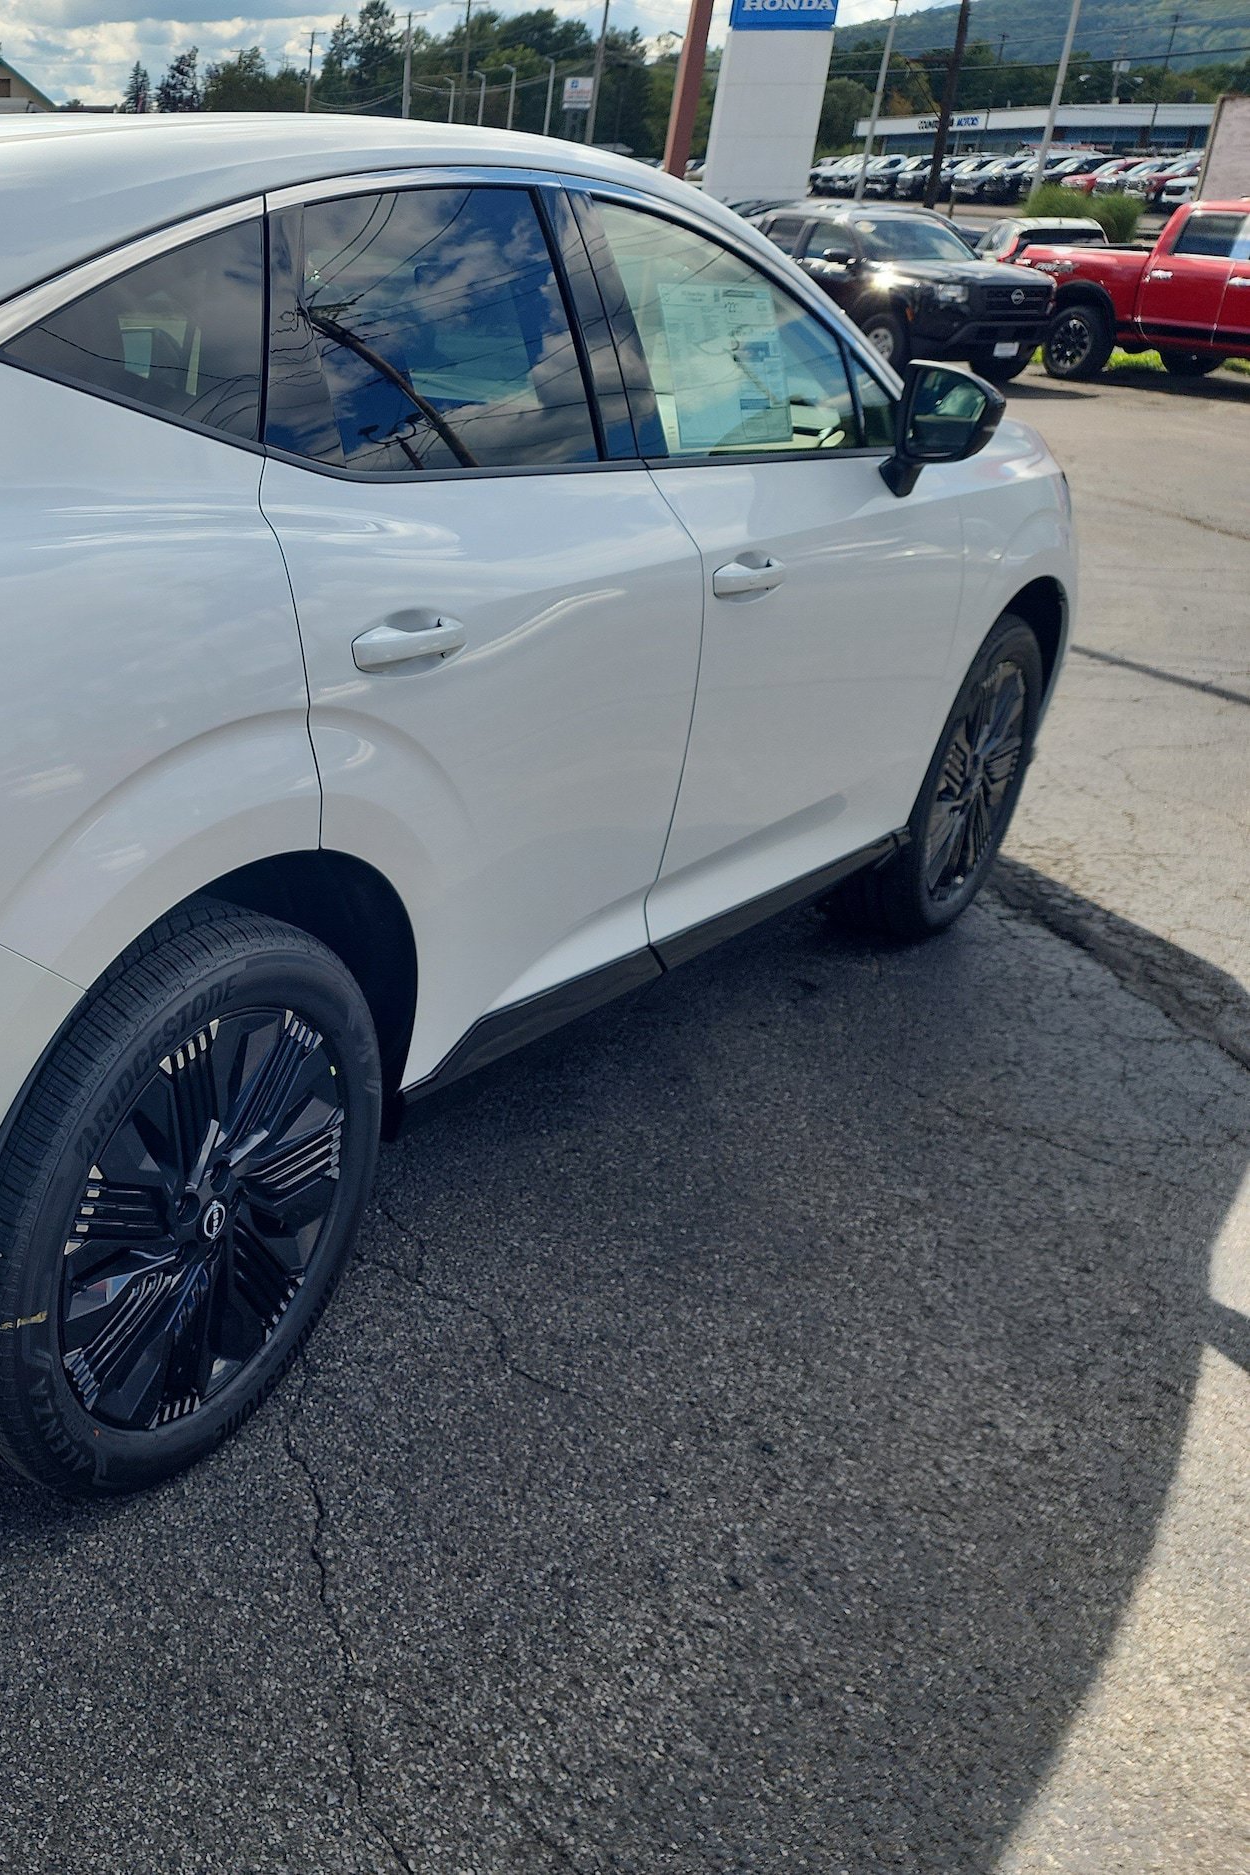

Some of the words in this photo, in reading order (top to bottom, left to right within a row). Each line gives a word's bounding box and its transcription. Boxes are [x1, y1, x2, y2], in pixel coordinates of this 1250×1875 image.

[742, 0, 835, 11] HONDA
[74, 974, 238, 1161] BRIDGESTONE
[28, 1377, 92, 1472] ALENZA
